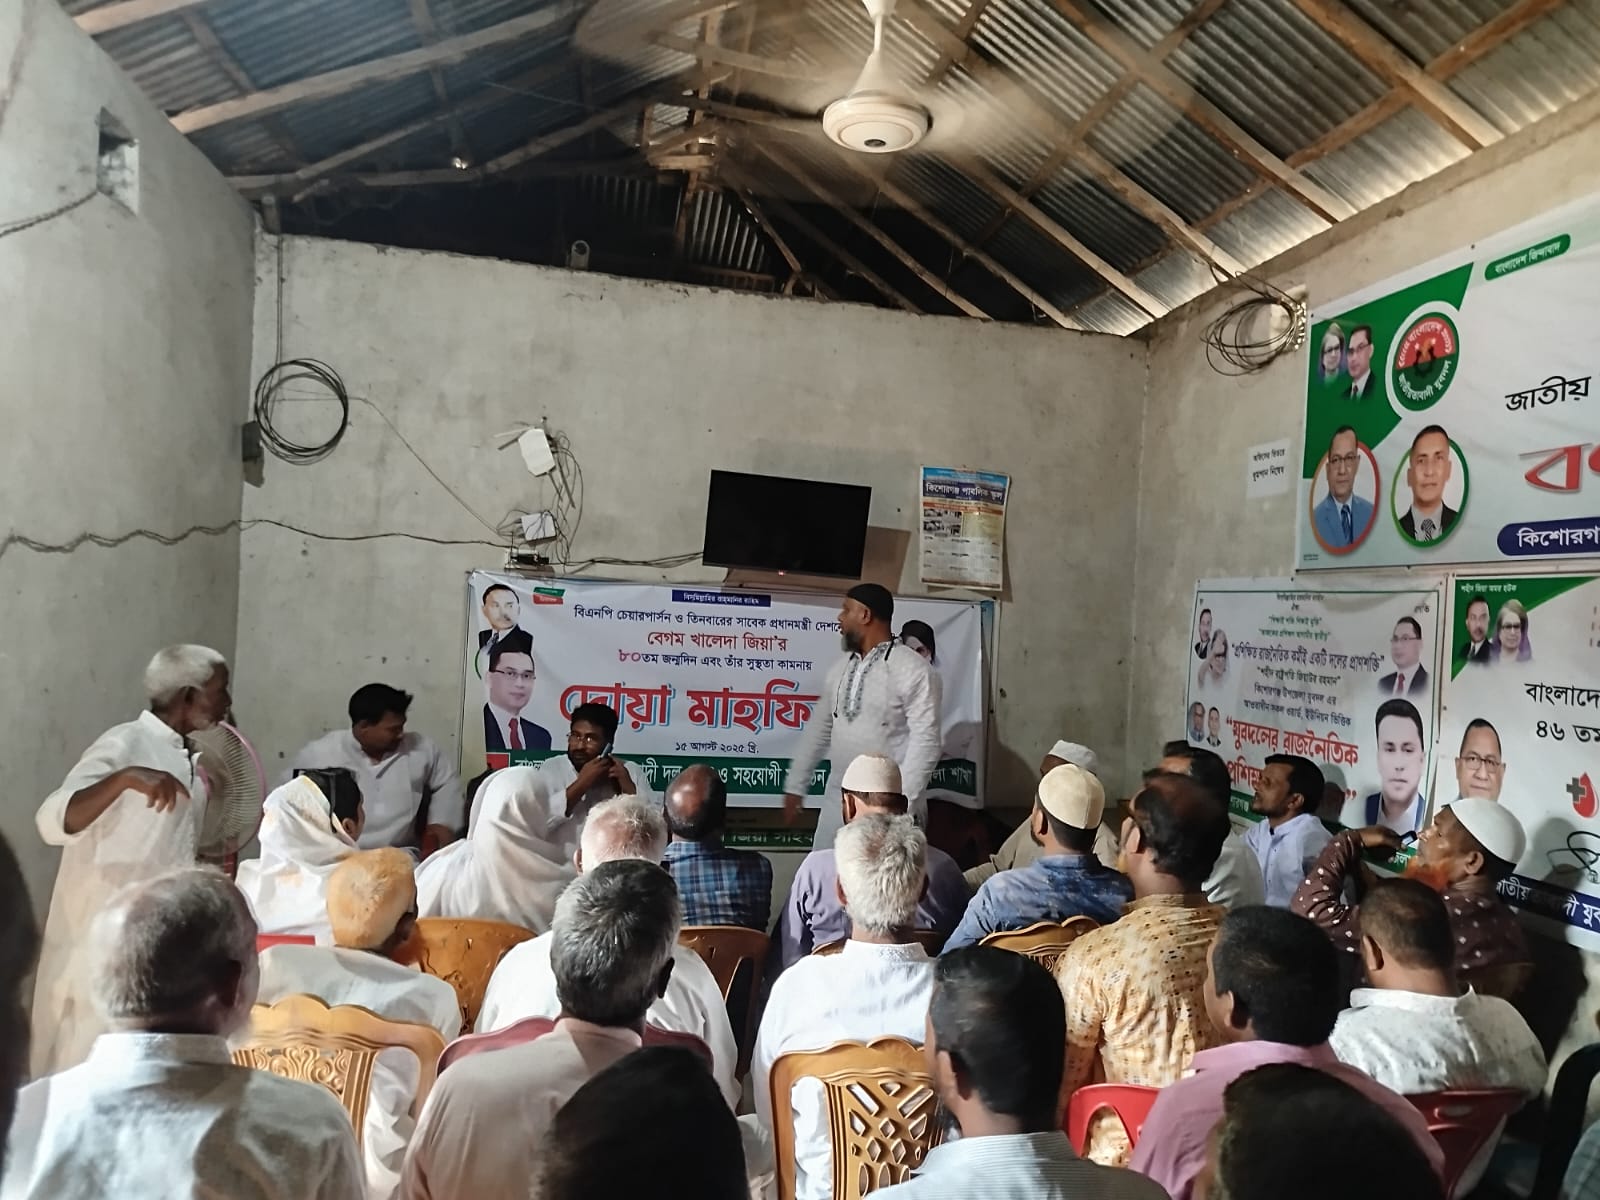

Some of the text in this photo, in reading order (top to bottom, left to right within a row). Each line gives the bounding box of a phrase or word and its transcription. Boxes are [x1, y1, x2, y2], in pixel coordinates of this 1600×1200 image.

[1505, 376, 1592, 411] জাতীয়
[1518, 443, 1600, 494] ব
[1516, 526, 1600, 547] কিশোরগ
[574, 604, 842, 632] বিএনপি চেয়ারপার্সন ও তিনবারের সাবেক প্রধানমন্ত্রী দেশনে
[648, 631, 685, 647] বেগম
[690, 632, 738, 650] খালেদা
[618, 649, 813, 672] ৮০তম জন্মদিন এবং তাঁর সুস্থতা কামনায়
[1259, 643, 1289, 662] রাজনৈতিক
[1309, 647, 1328, 667] একটি
[1328, 653, 1348, 670] দলের
[687, 678, 821, 735] মাহফি
[1524, 682, 1600, 709] বাংলাদে
[1536, 720, 1565, 741] ৪৬
[675, 742, 687, 751] ১৫
[721, 743, 745, 753] ২০২৫
[1283, 728, 1359, 769] রাজনৈতিক
[733, 761, 782, 786] সহযোগী
